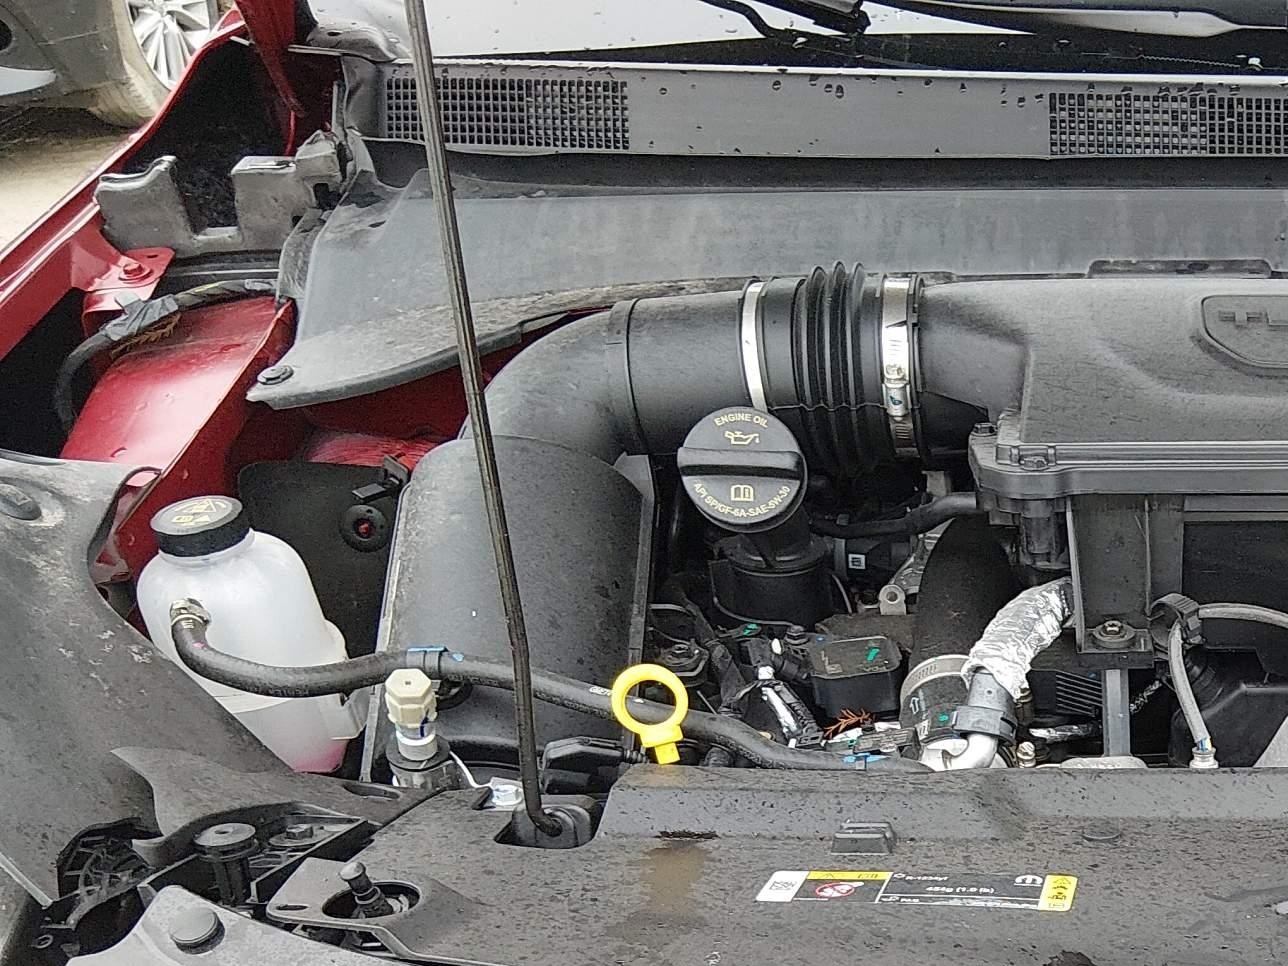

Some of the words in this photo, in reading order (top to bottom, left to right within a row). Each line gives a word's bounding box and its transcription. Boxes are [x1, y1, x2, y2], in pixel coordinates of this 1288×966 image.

[714, 413, 751, 426] ENGINE
[752, 415, 768, 428] OIL
[693, 483, 706, 498] API
